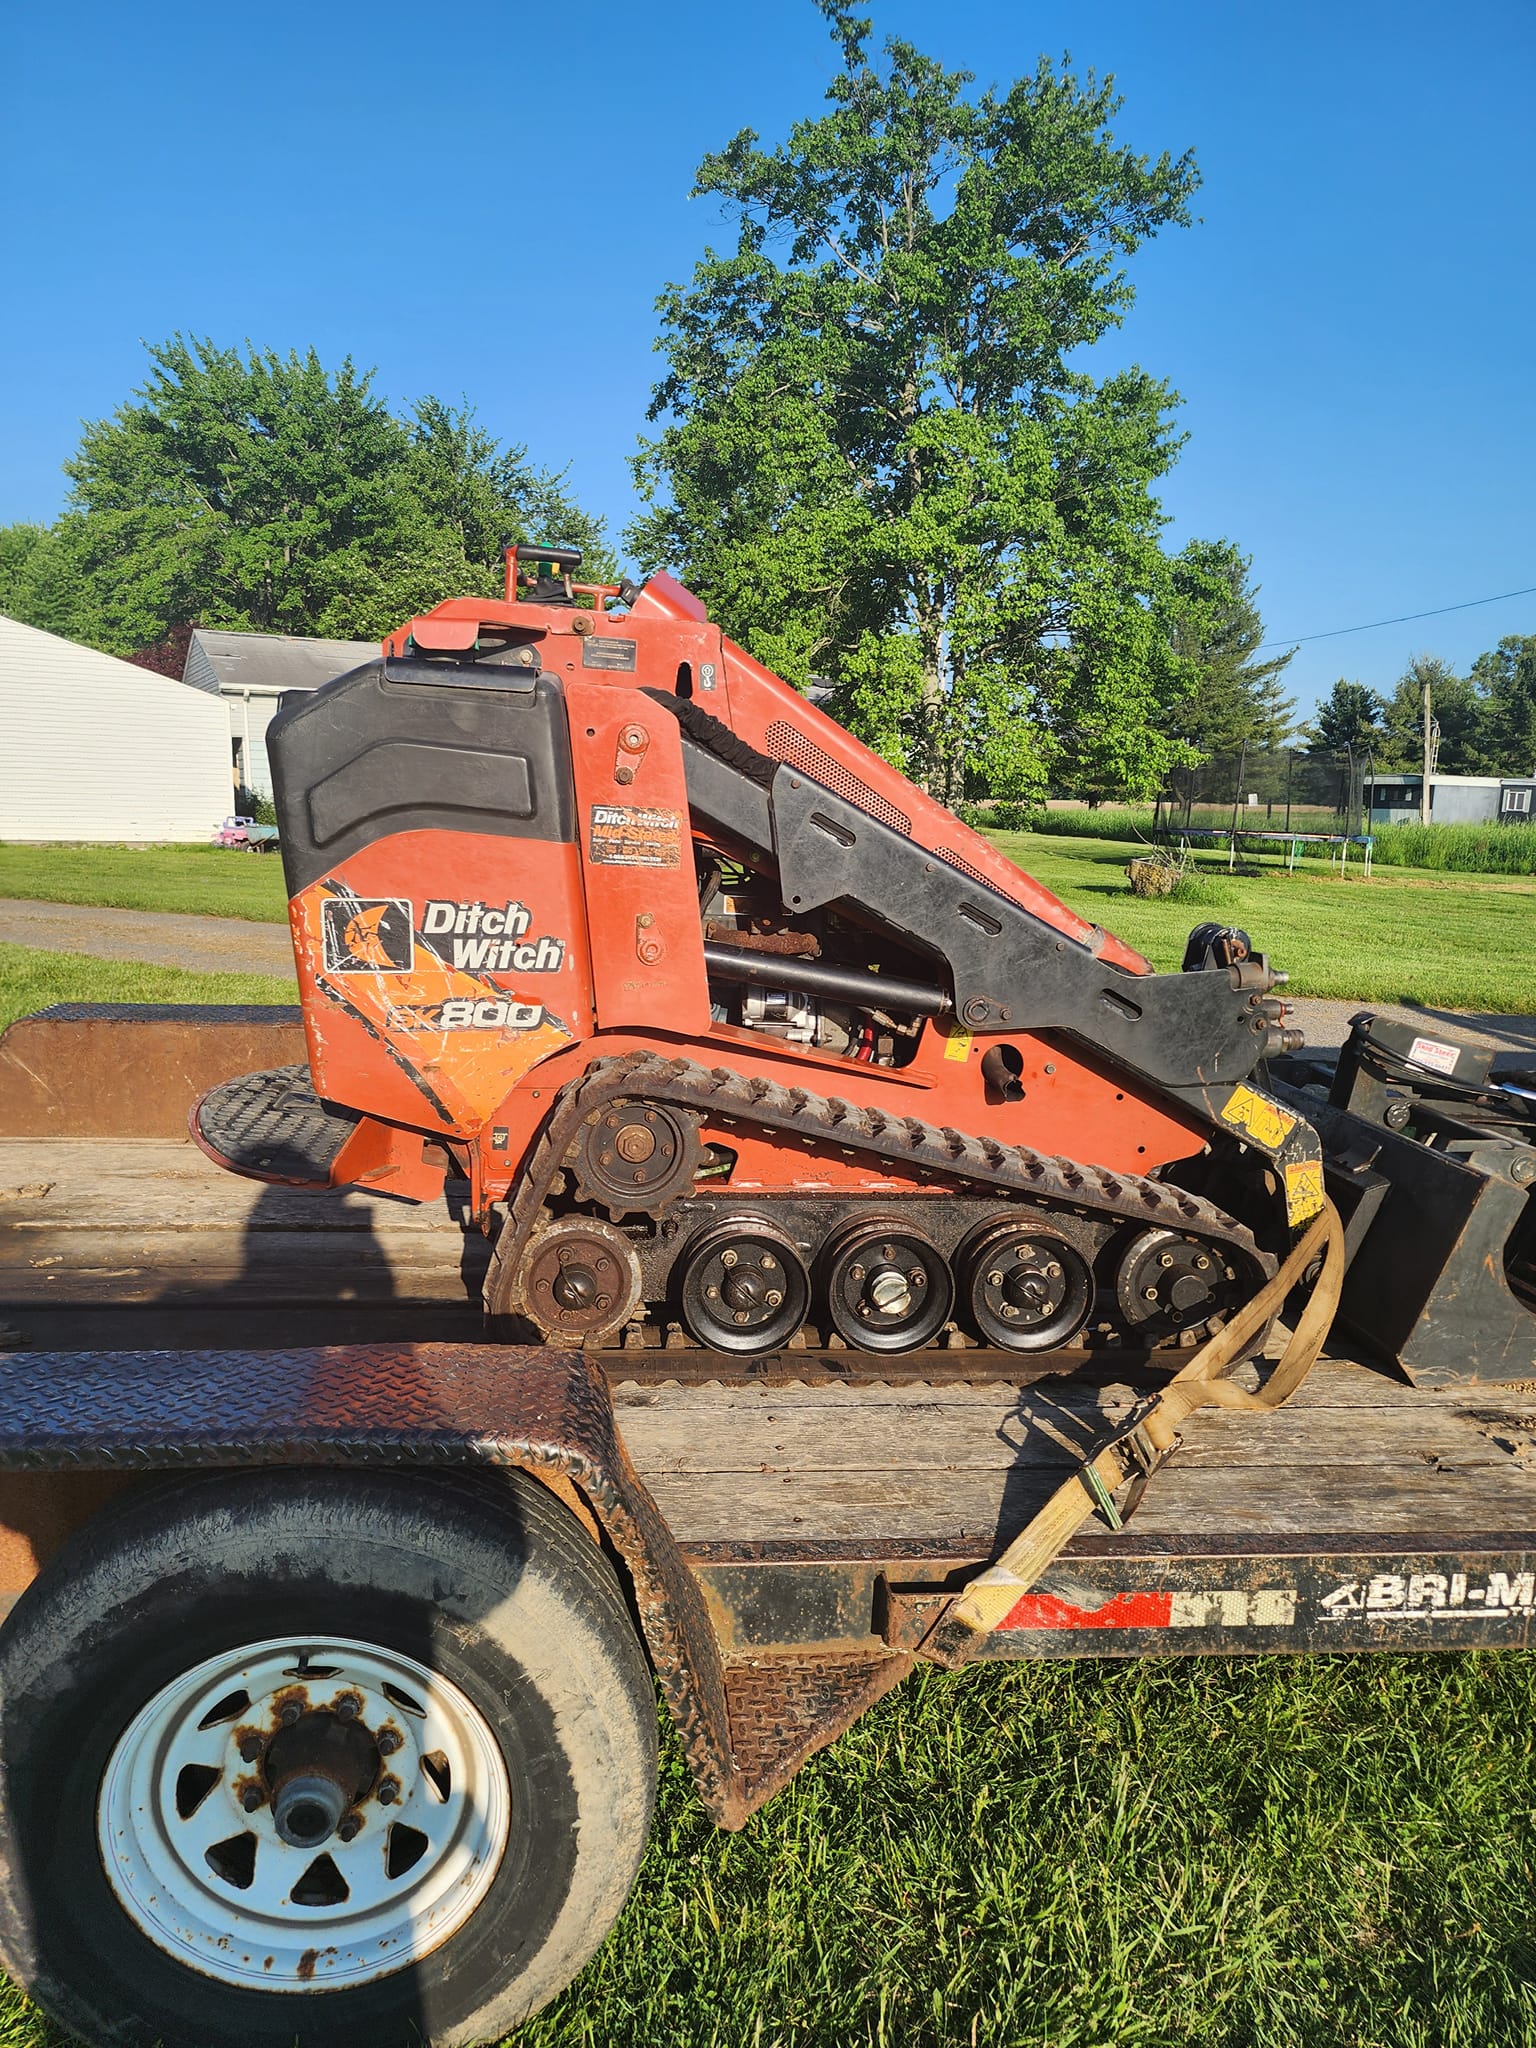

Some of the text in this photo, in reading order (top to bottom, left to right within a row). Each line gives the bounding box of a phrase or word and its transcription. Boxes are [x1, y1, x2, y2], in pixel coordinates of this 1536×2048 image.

[424, 902, 529, 935] Ditch
[453, 935, 561, 969] Witch
[1366, 1572, 1536, 1608] BRI-M
